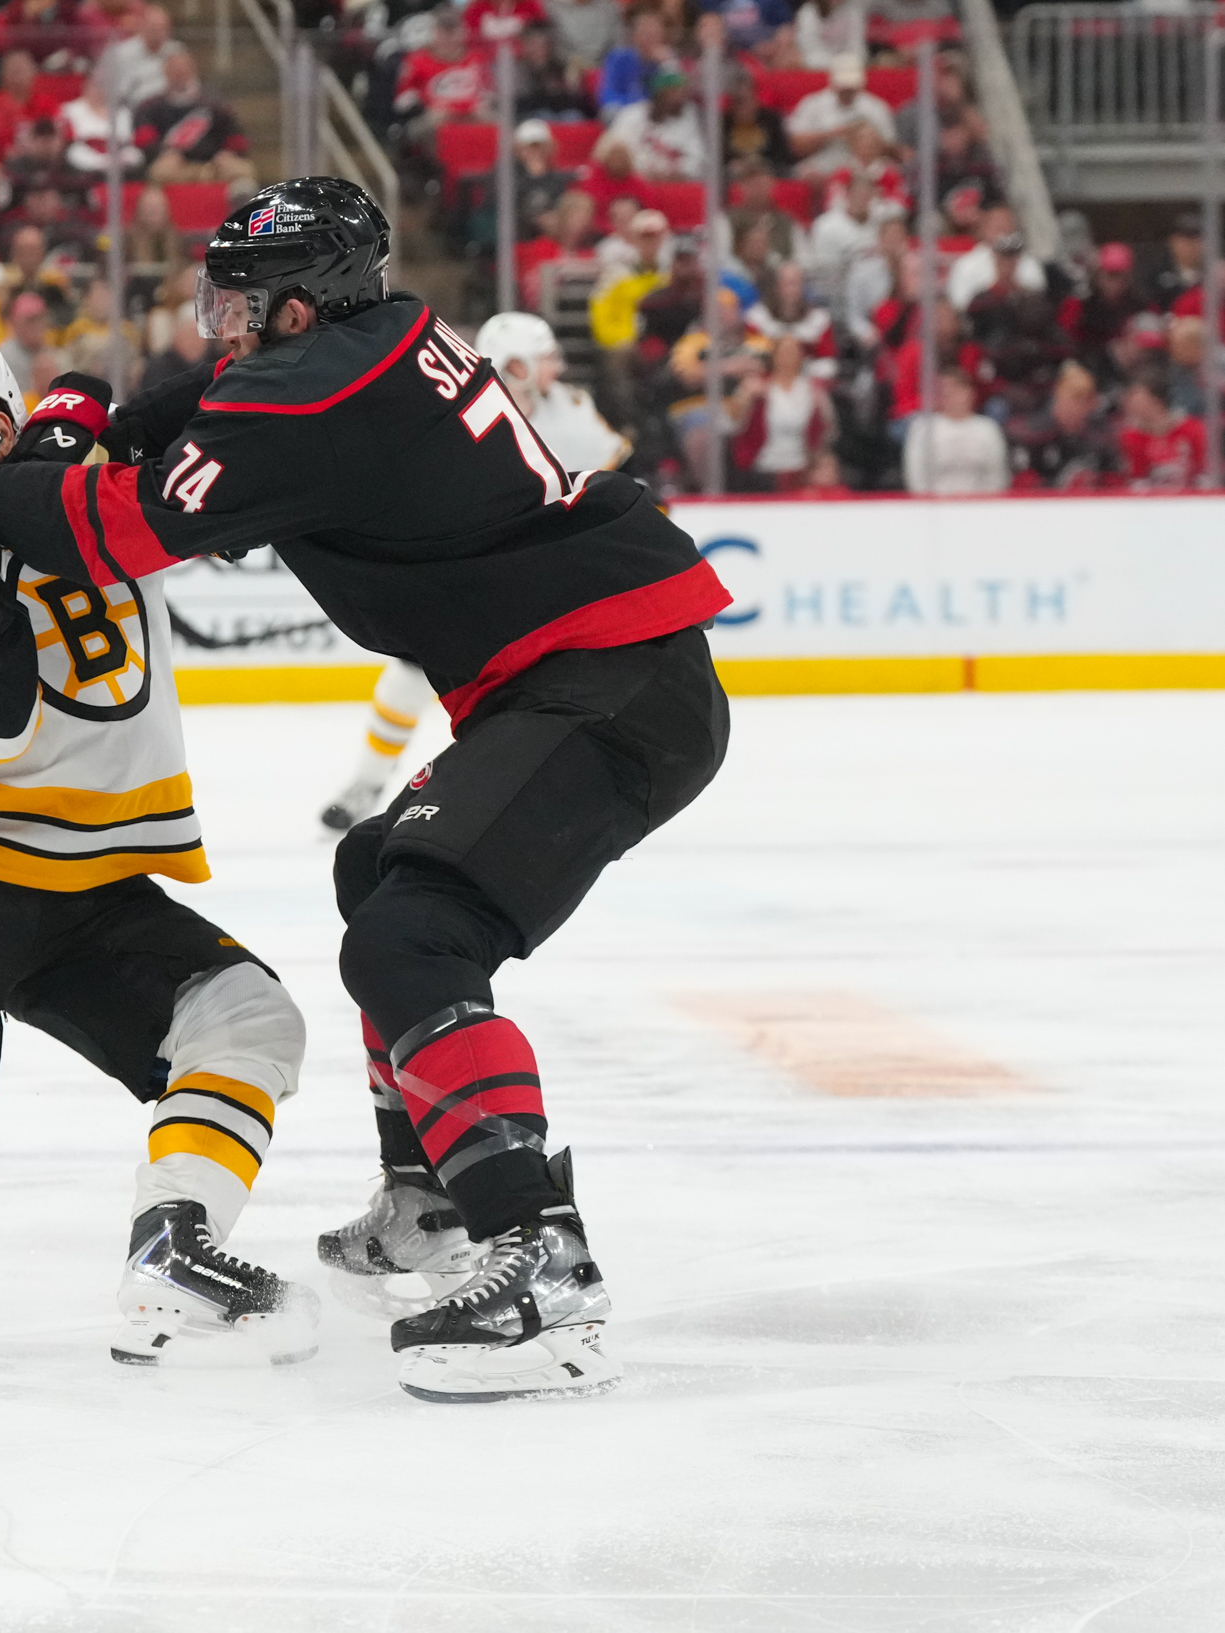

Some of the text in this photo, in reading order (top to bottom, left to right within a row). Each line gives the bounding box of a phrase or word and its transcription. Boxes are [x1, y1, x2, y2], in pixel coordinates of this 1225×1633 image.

[276, 213, 315, 223] Citizens
[276, 223, 302, 234] Bank
[162, 440, 225, 514] 74
[782, 581, 1069, 625] HEALTH
[34, 578, 128, 683] B
[191, 1263, 244, 1289] BAUER
